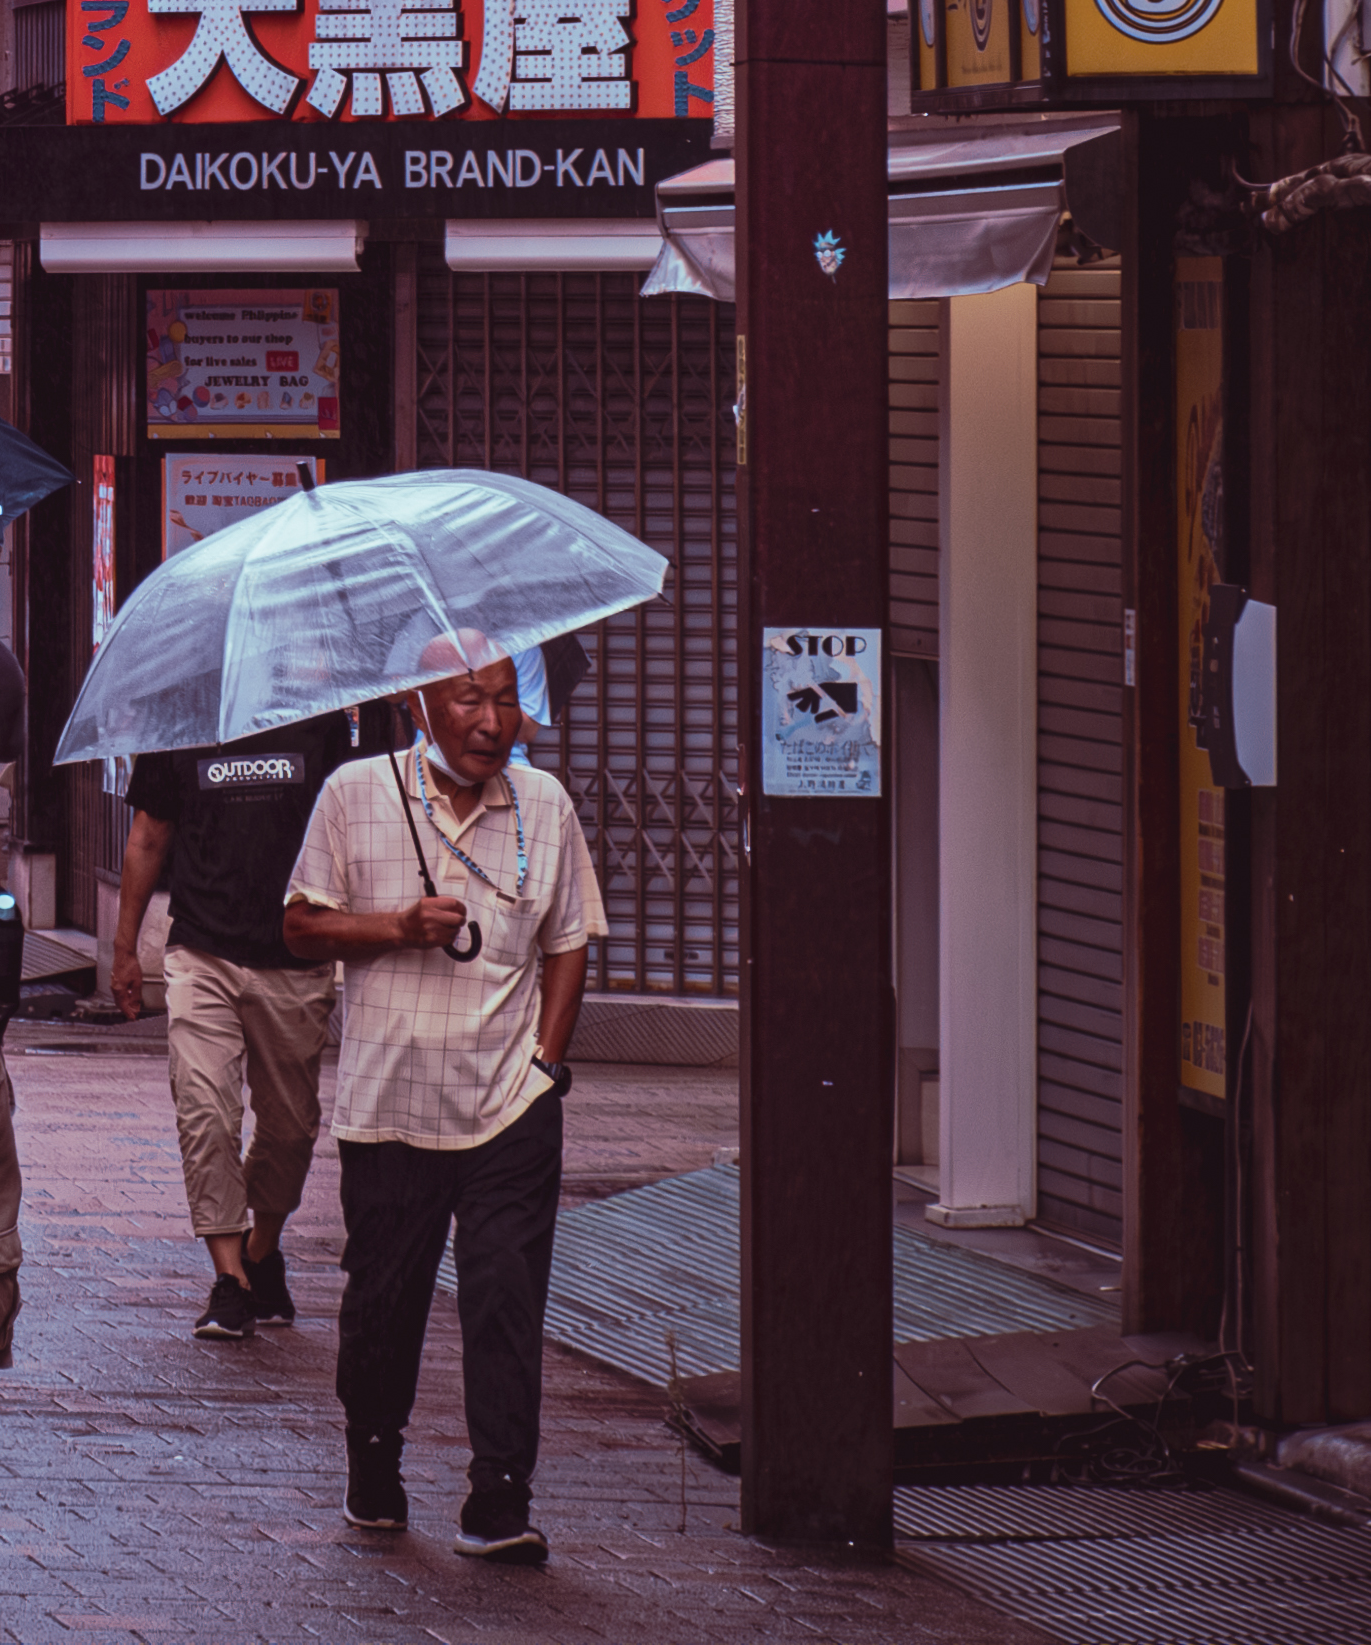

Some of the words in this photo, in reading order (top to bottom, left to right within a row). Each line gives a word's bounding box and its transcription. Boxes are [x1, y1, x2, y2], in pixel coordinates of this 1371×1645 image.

[140, 152, 382, 191] DAIKOKU-YA
[404, 148, 645, 188] BRAND-KAN
[226, 335, 239, 344] to
[265, 333, 294, 346] shop
[184, 356, 203, 366] for
[206, 356, 227, 366] live
[269, 355, 295, 368] LIVE
[204, 375, 271, 387] JEWELRY
[279, 375, 310, 387] BAG
[787, 635, 868, 657] STOP
[207, 758, 293, 783] OUTDOOR
